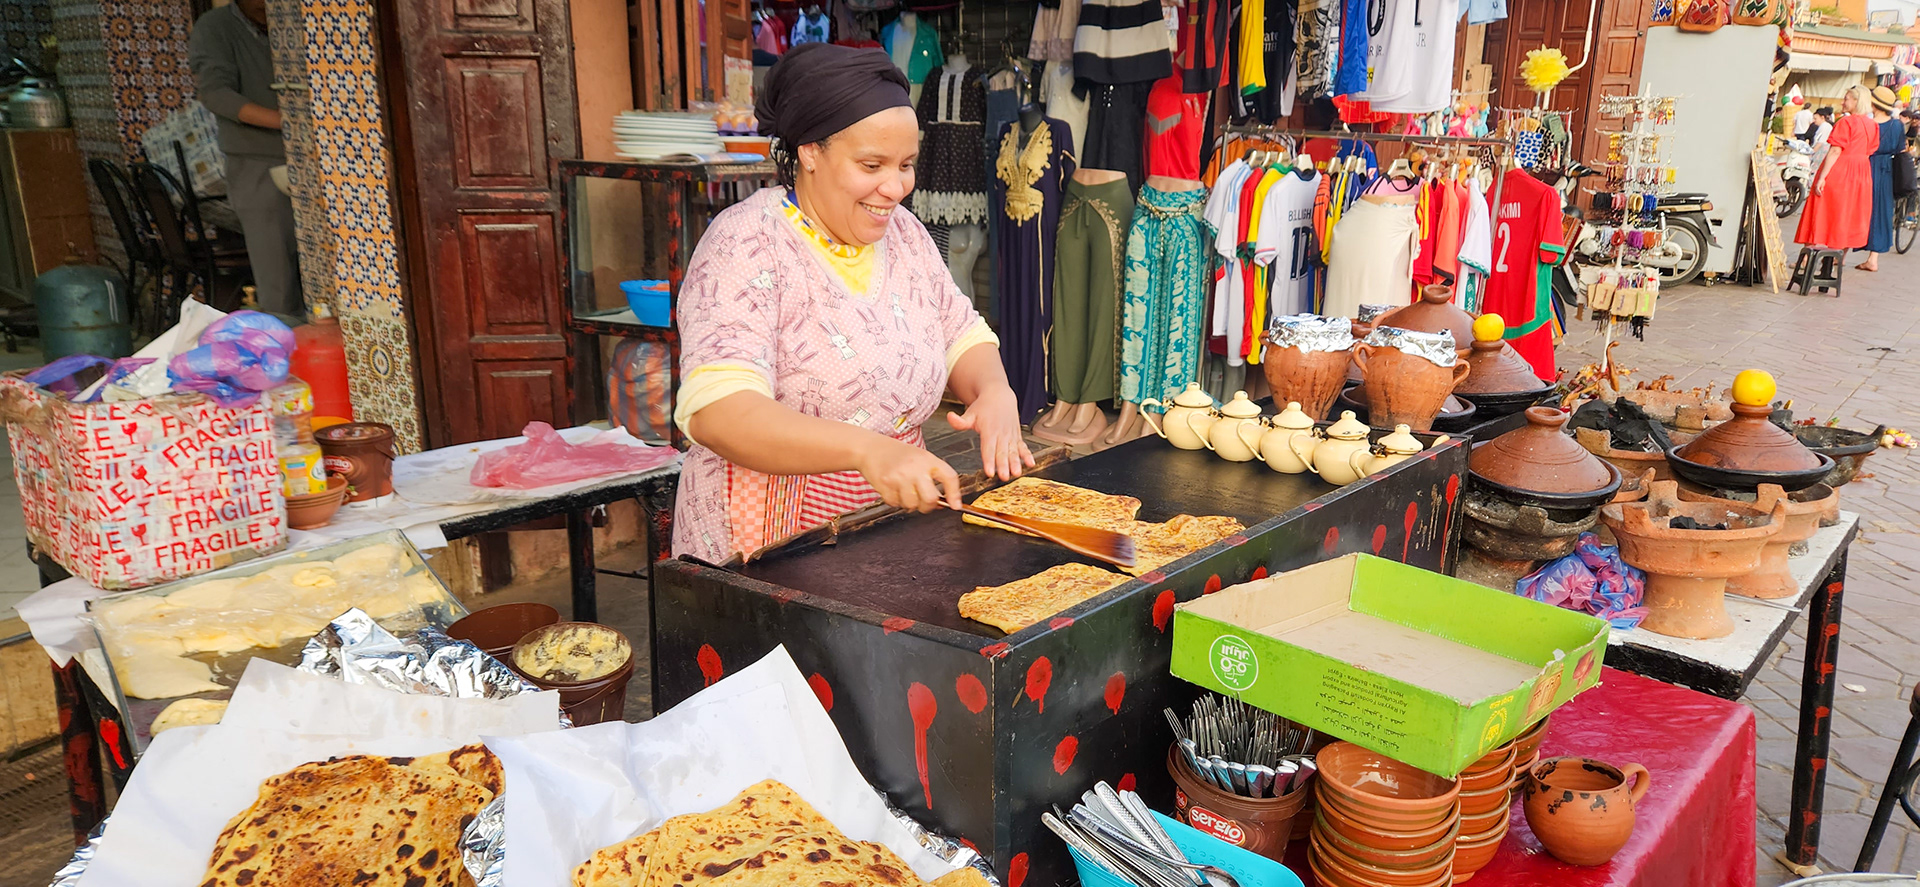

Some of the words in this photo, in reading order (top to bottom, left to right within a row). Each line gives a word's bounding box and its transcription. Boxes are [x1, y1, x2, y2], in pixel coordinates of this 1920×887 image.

[1496, 222, 1511, 273] 2
[169, 490, 273, 537] FRAGILE
[154, 523, 263, 568] FRAGILE
[1221, 644, 1250, 660] الريان
[1323, 682, 1349, 695] Packaging
[1376, 692, 1407, 707] Agricultural
[1191, 808, 1242, 840] sergio
